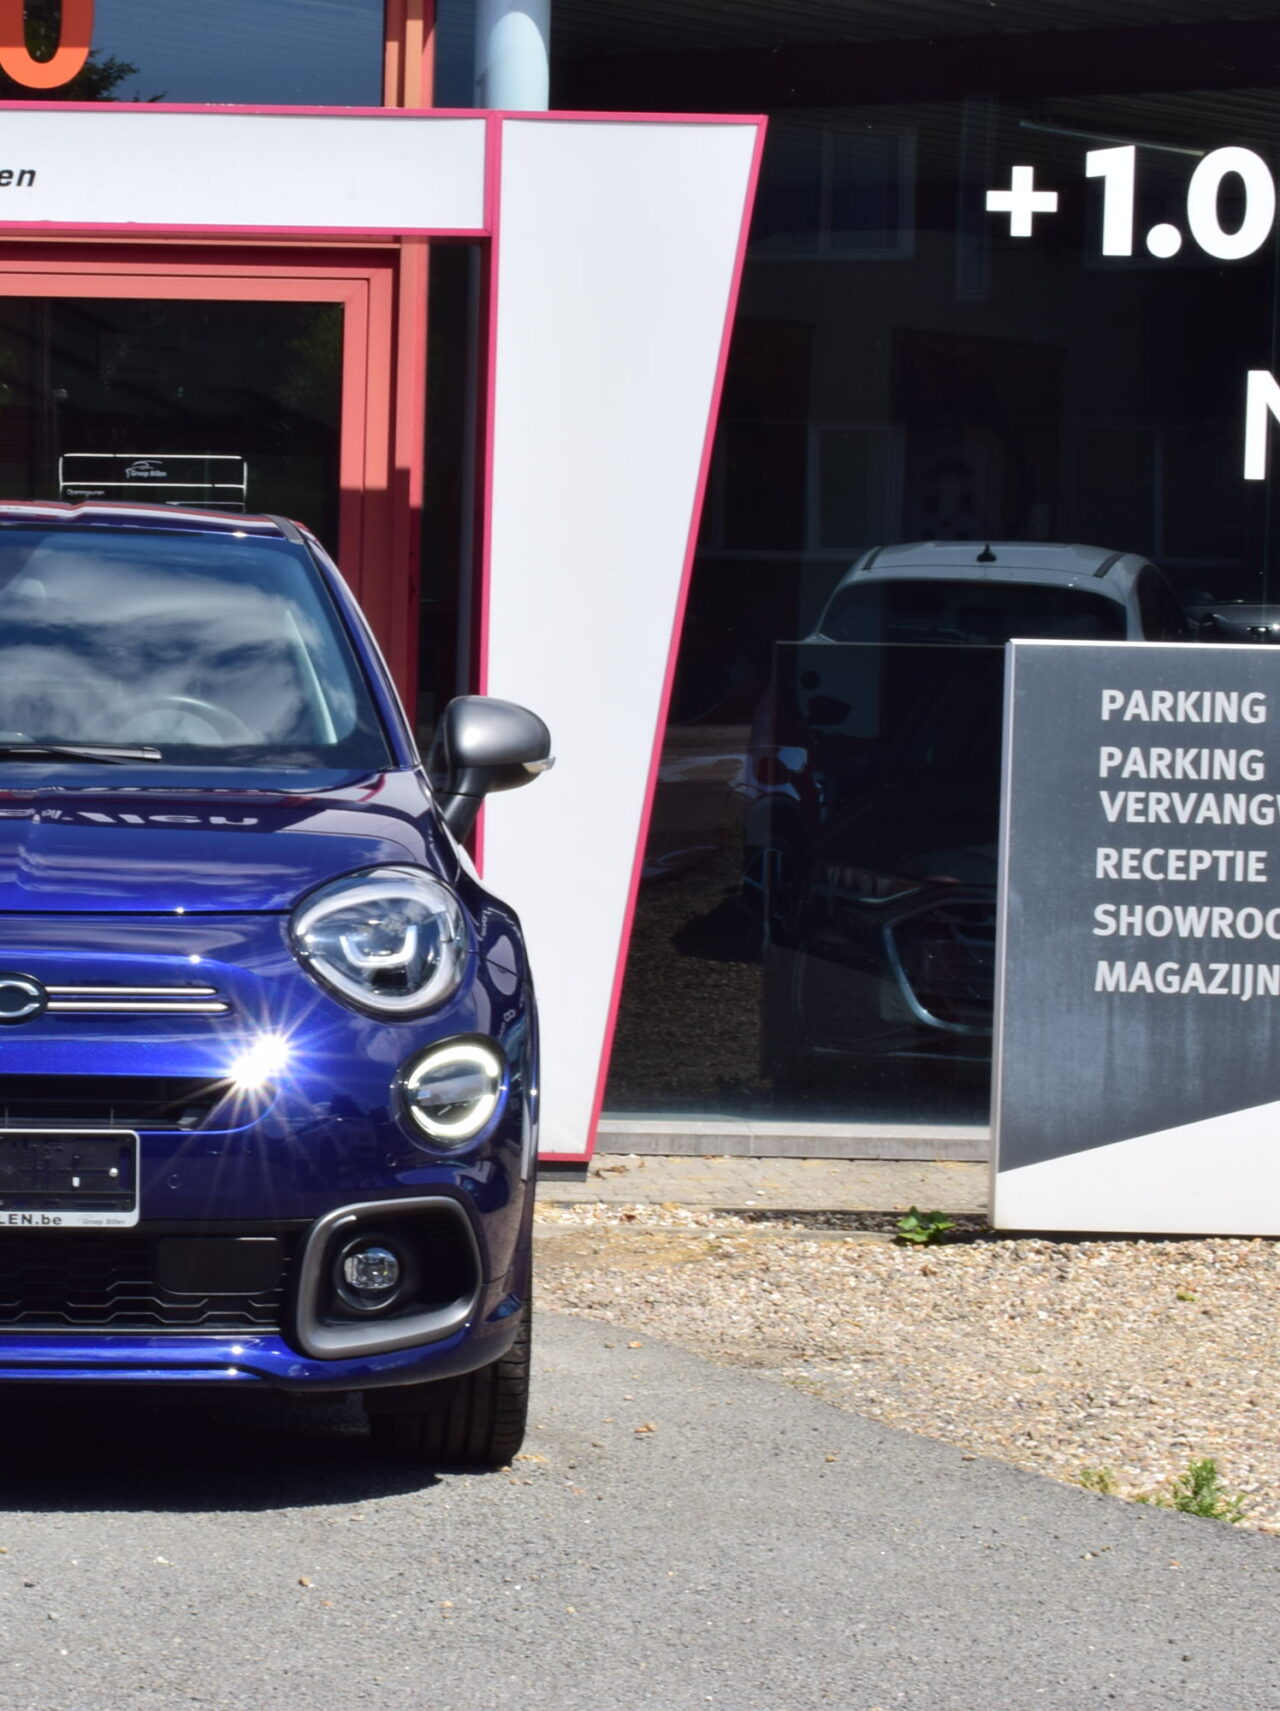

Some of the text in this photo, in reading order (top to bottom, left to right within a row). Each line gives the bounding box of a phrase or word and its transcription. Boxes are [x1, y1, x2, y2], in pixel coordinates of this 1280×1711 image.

[1101, 689, 1267, 723] PARKING
[1099, 746, 1265, 781] PARKING
[1099, 790, 1280, 826] VERVANG
[1095, 847, 1268, 883] RECEPTIE
[1094, 960, 1280, 1002] MAGAZIJN
